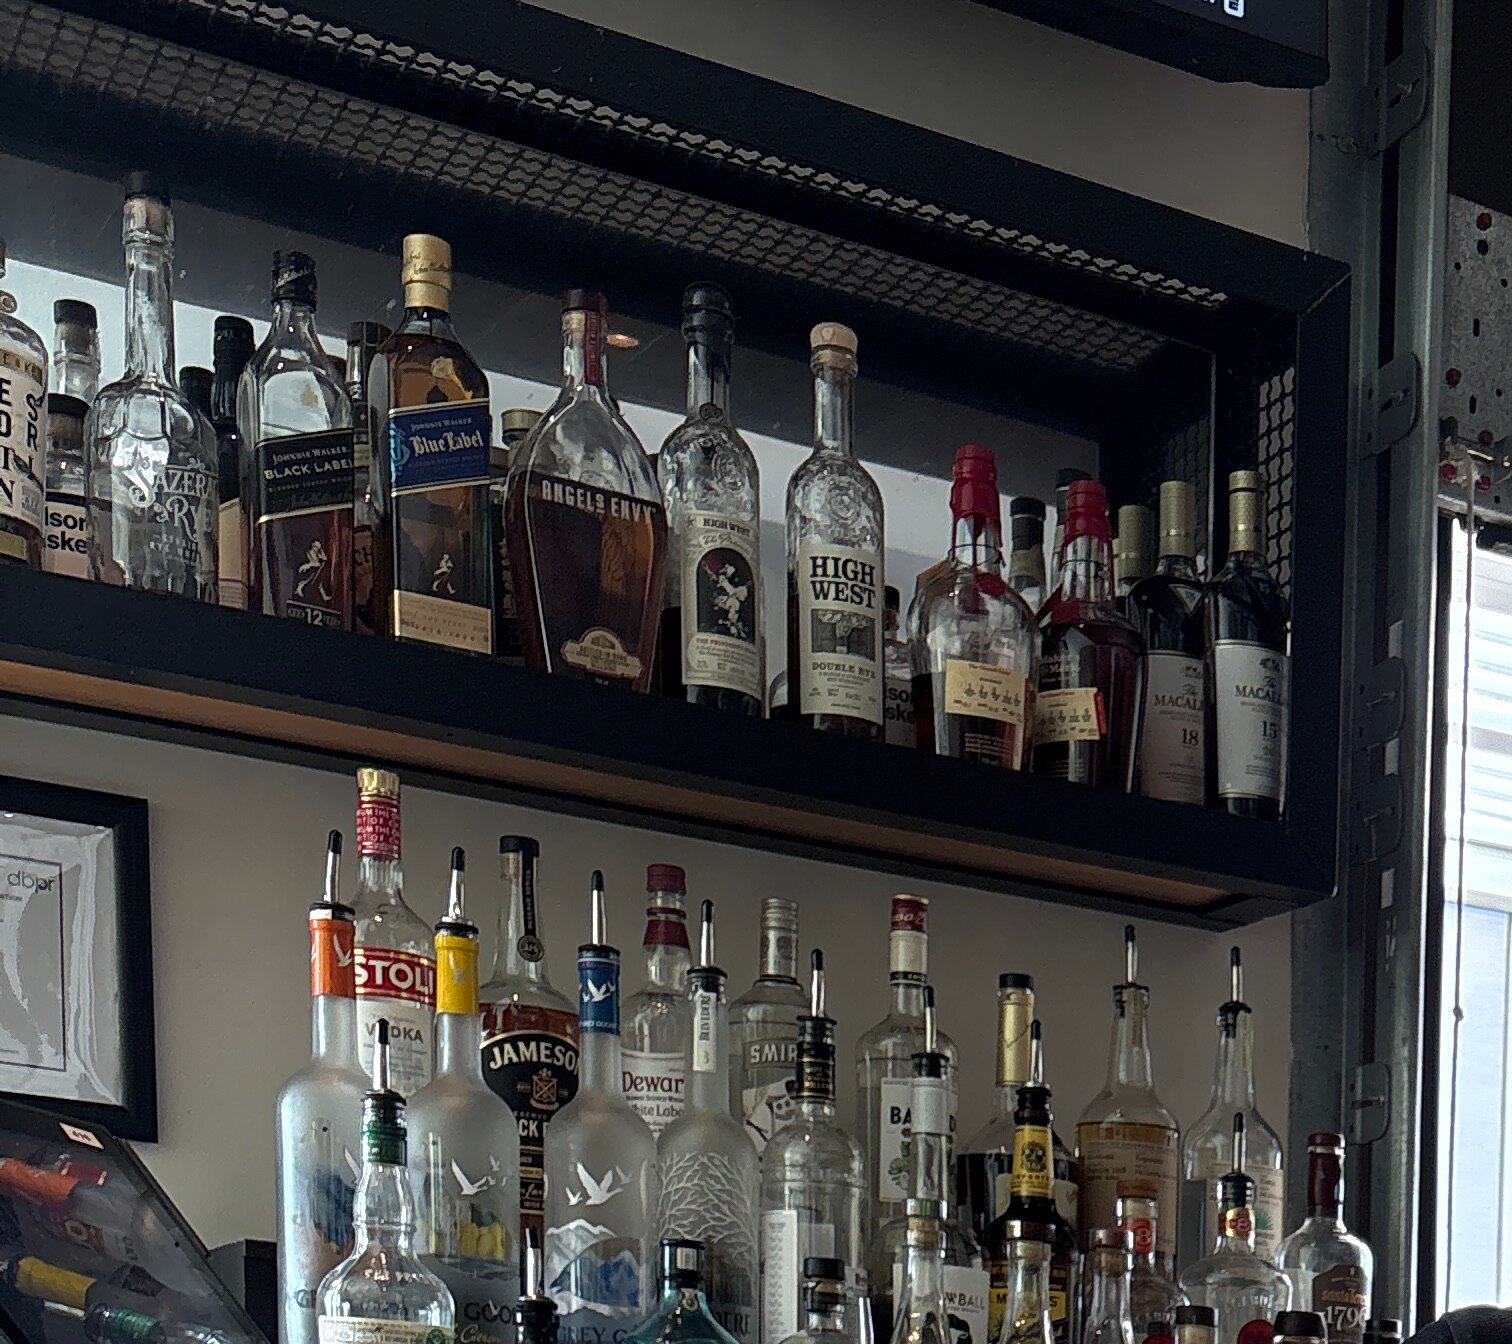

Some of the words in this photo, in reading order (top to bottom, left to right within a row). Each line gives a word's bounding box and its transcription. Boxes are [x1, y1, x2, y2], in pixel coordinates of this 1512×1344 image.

[409, 432, 447, 456] Blue
[445, 429, 484, 452] Label
[263, 464, 312, 481] BLACK
[610, 496, 658, 525] ENVY
[703, 517, 729, 530] HIGH
[809, 555, 876, 588] HIGH
[810, 579, 877, 610] WEST
[303, 607, 325, 627] 12
[811, 661, 856, 675] DOUBLE
[1154, 694, 1204, 711] MACAL
[1181, 727, 1199, 746] 18
[1262, 720, 1278, 740] 15
[7, 870, 56, 894] dbpr
[354, 957, 434, 996] STOLI
[365, 1023, 424, 1044] VDKA
[489, 1039, 580, 1075] JAMESO
[750, 1043, 798, 1064] SMIR
[622, 1071, 685, 1094] Dewar
